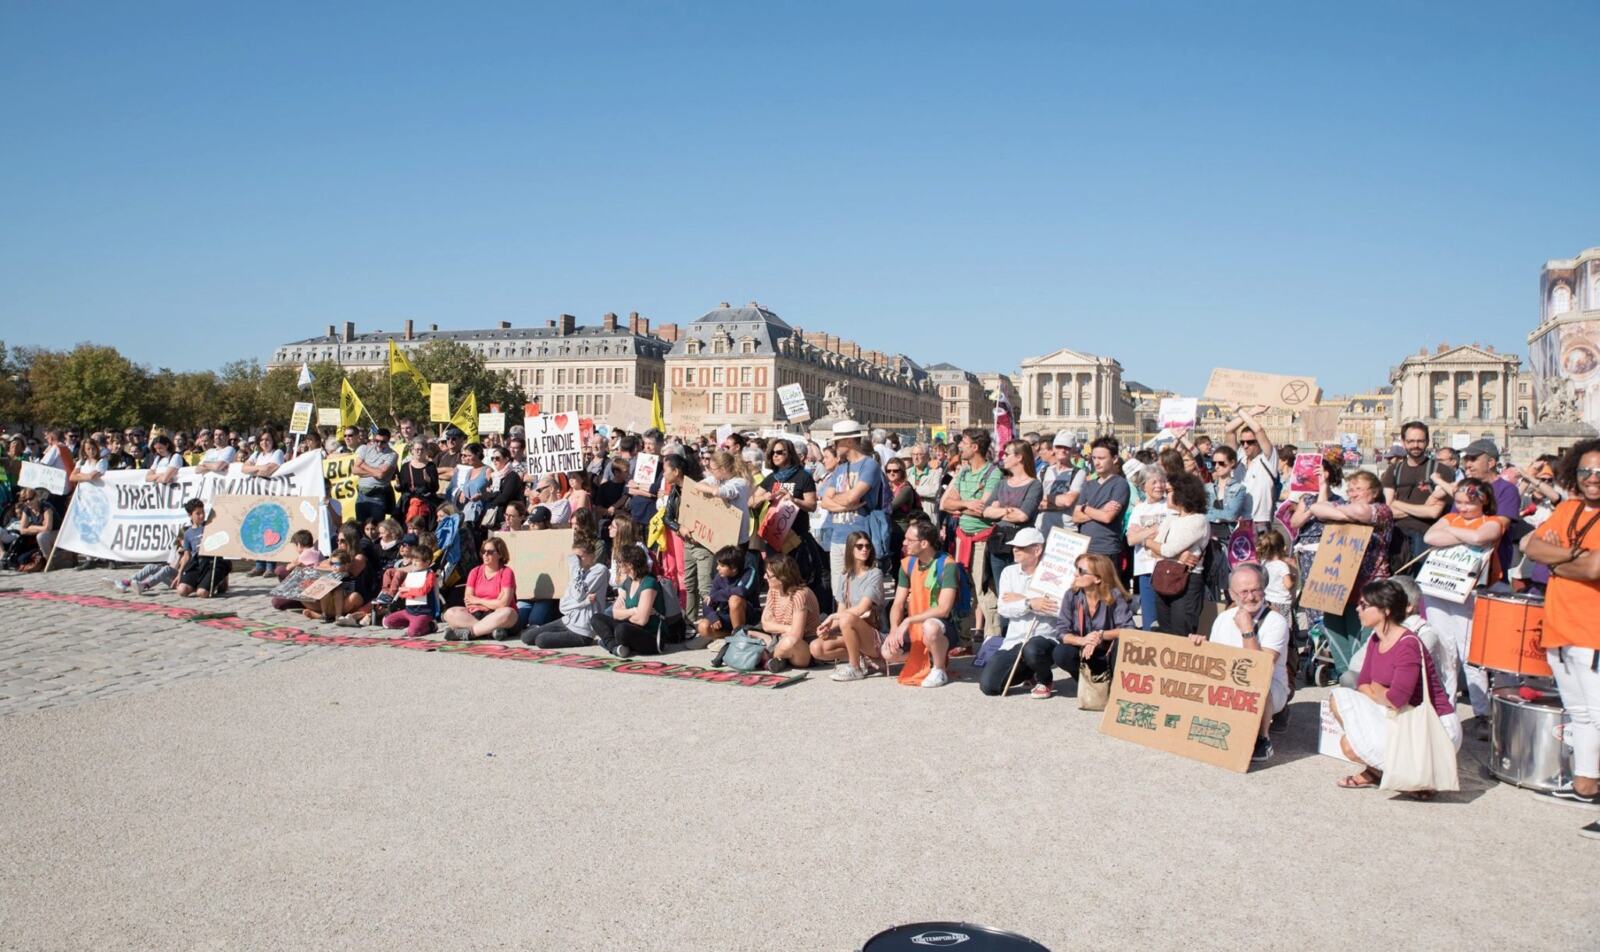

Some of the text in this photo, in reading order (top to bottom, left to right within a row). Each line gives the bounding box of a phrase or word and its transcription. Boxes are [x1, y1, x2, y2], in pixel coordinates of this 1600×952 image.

[527, 432, 575, 455] LA FONDUE
[528, 452, 582, 474] PAS LA FONTE
[115, 472, 297, 510] URGENCE CIMATIQUE
[110, 523, 180, 551] AGISSON
[1324, 566, 1340, 577] MA
[1122, 641, 1157, 668] POUR
[1120, 670, 1261, 715] VOUS VOULEZ VENDRE
[1115, 698, 1161, 731] TERRE
[1186, 715, 1232, 751] MER
